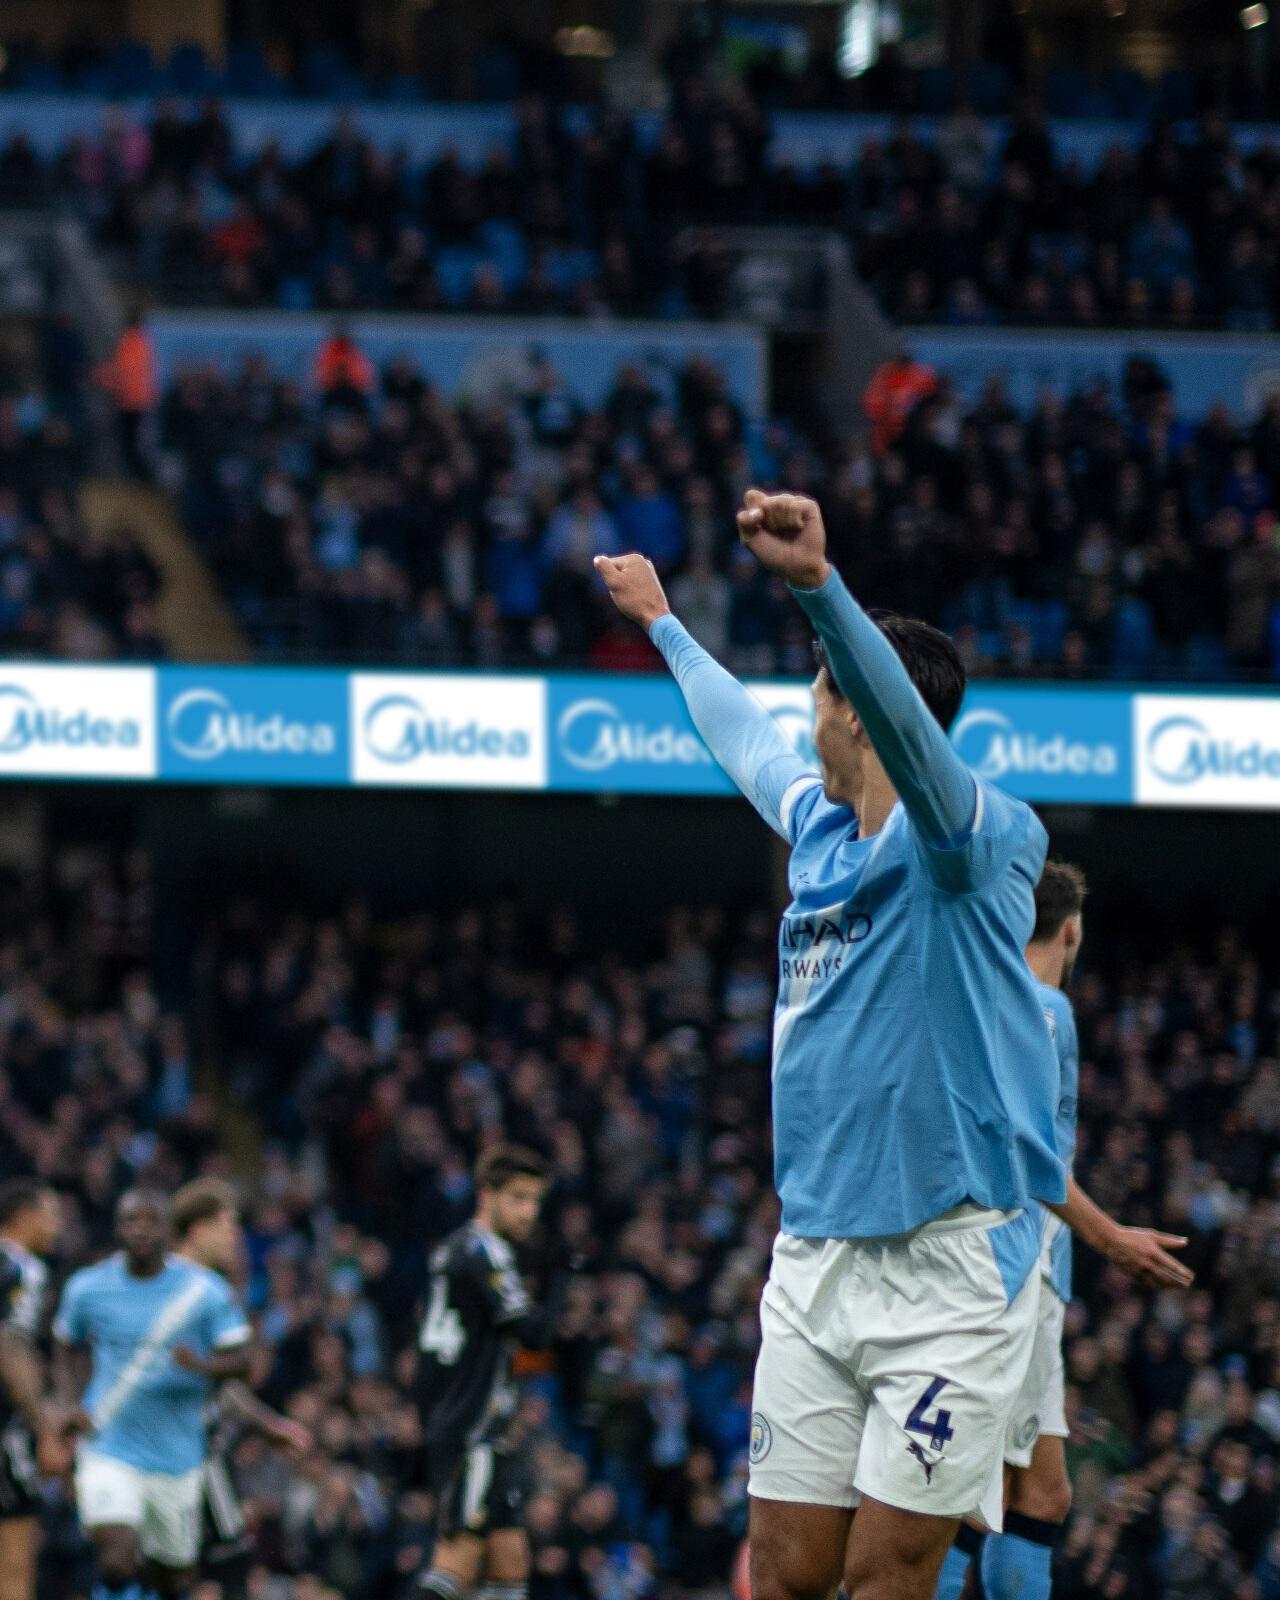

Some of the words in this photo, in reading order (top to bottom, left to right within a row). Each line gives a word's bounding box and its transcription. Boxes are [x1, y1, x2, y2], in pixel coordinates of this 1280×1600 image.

[6, 704, 141, 748] Midea
[199, 709, 334, 753] Midea
[395, 714, 531, 758] Midea
[587, 720, 712, 762] Mide
[983, 732, 1118, 776] Midea
[1178, 738, 1280, 780] Mide
[783, 912, 872, 947] IHAD
[783, 958, 842, 979] RWAYS
[420, 1275, 466, 1364] 4
[904, 1376, 954, 1452] 4
